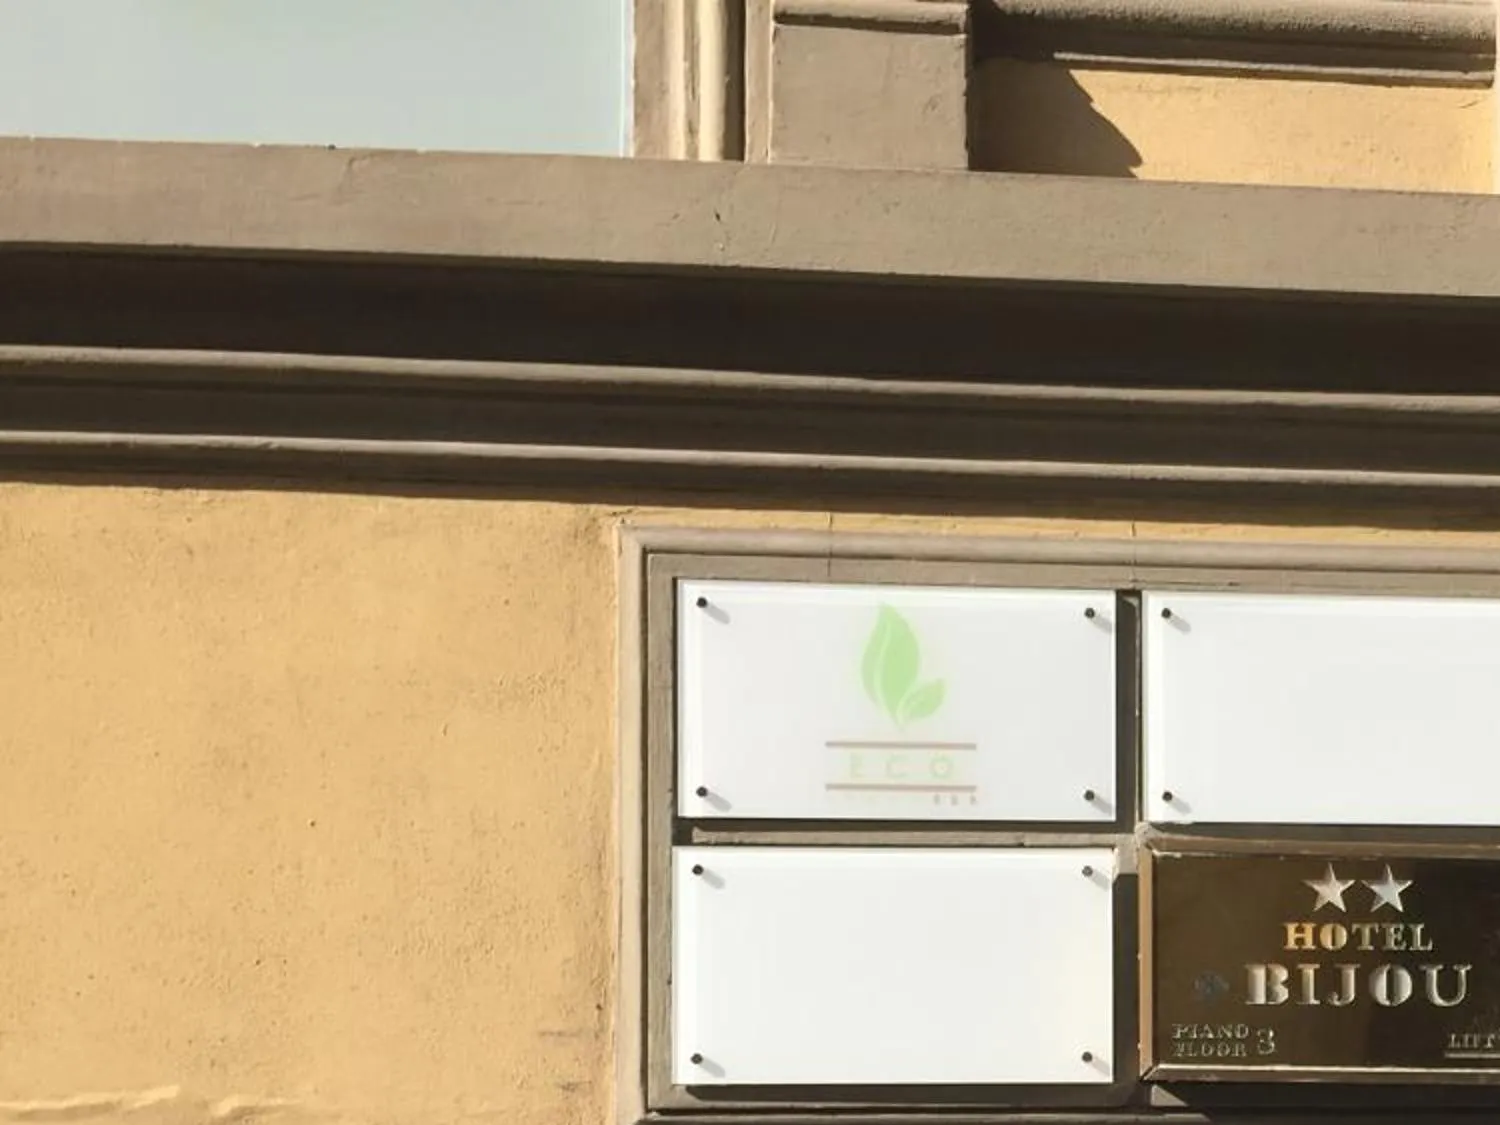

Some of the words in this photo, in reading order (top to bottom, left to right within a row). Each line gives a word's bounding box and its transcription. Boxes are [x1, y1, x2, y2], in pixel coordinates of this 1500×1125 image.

[850, 753, 953, 779] ECO
[1283, 921, 1433, 951] HOTEL
[1244, 963, 1473, 1007] BIJOU
[1171, 1023, 1249, 1039] PIANO
[1256, 1026, 1276, 1055] 3
[1447, 1032, 1496, 1048] LIFT
[1171, 1041, 1247, 1057] FLOOR
